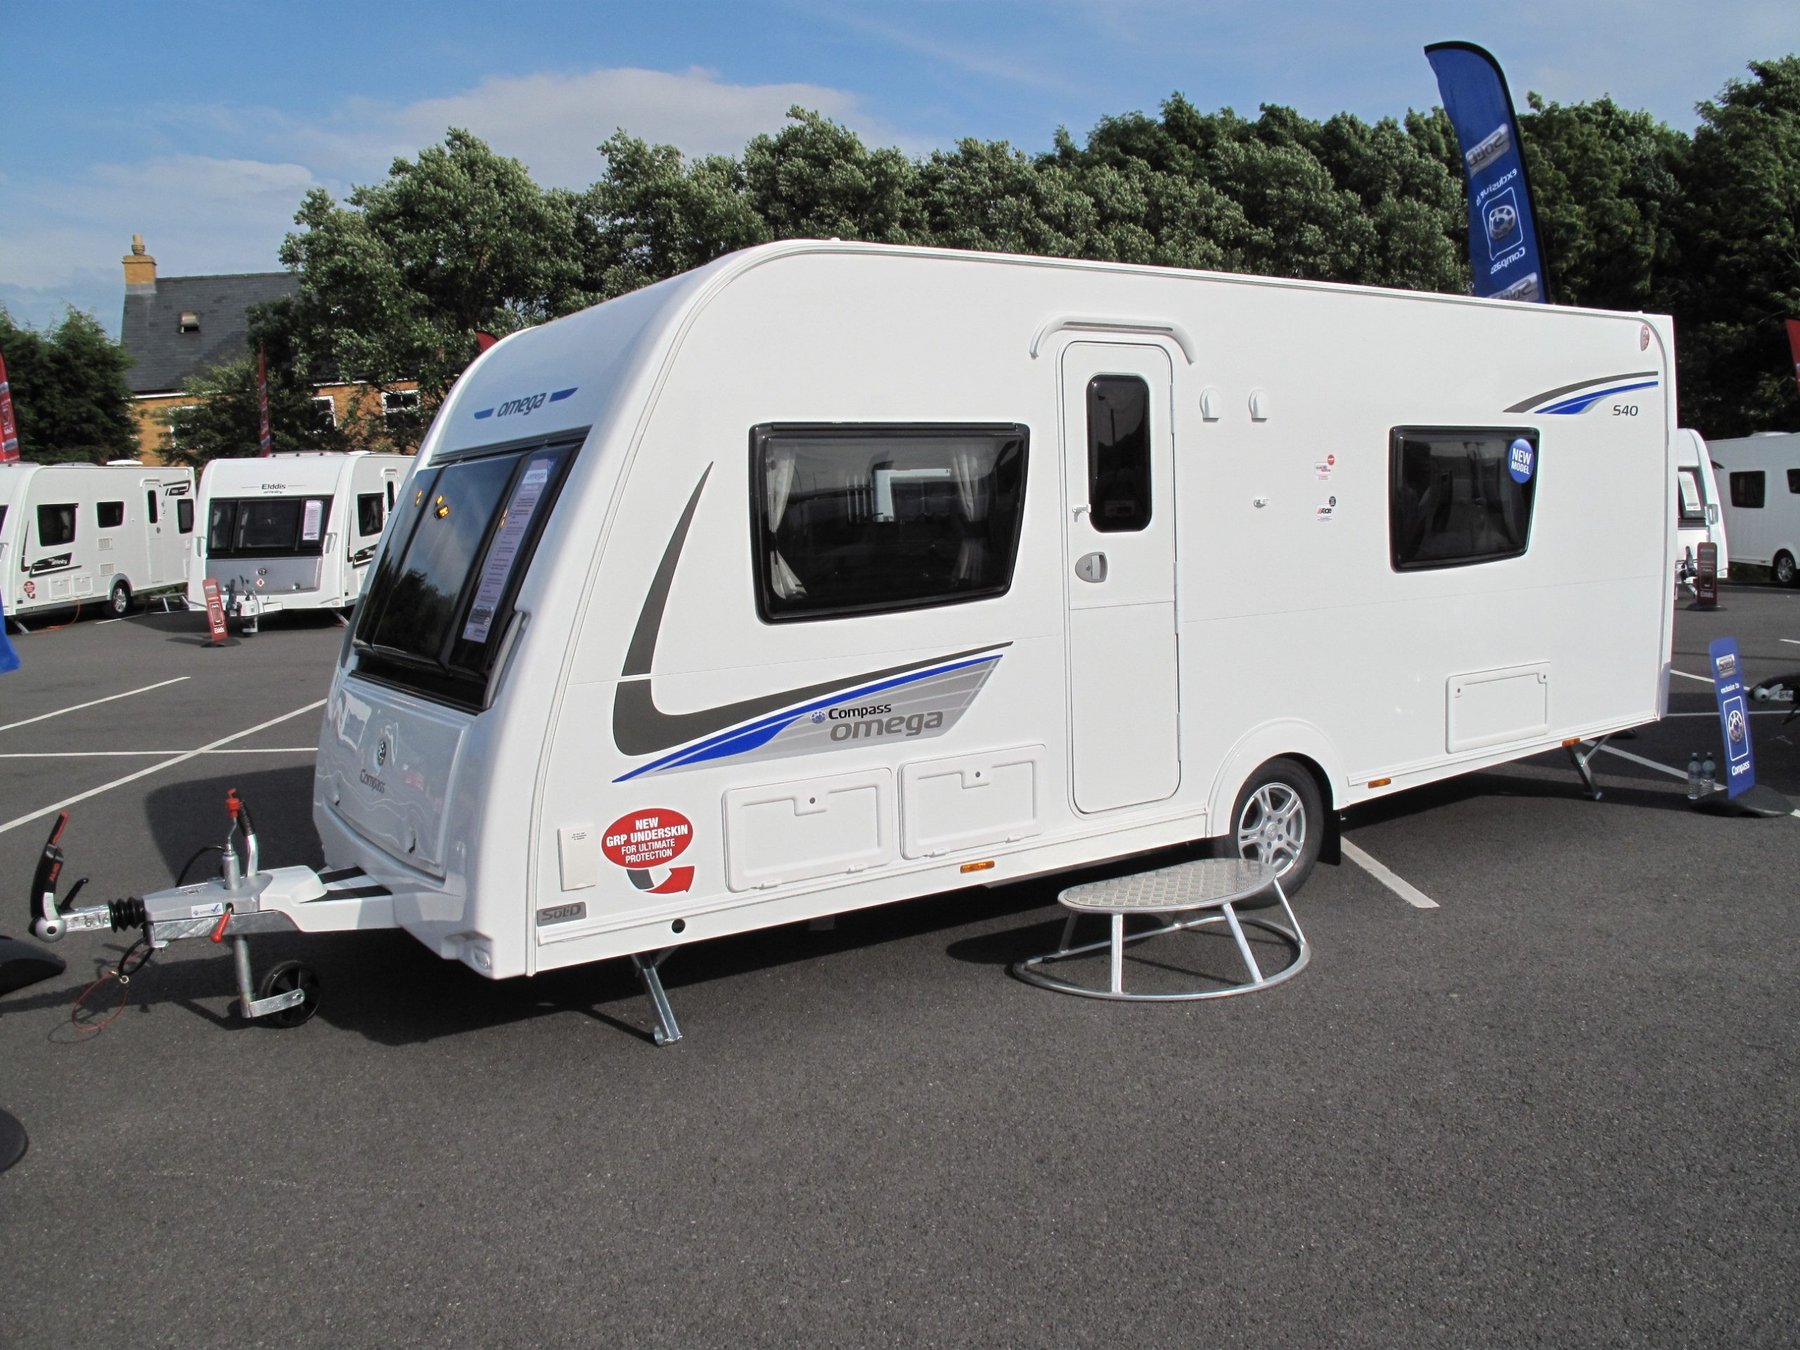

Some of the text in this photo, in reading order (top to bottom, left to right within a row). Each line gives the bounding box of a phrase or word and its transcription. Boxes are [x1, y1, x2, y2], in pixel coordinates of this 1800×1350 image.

[497, 392, 548, 418] omega
[1612, 404, 1639, 416] 540
[1511, 447, 1532, 465] NEW
[1510, 460, 1530, 475] MODEL
[828, 703, 892, 720] Compass
[830, 711, 944, 742] omega
[635, 817, 659, 831] NEW
[606, 834, 627, 847] GRP
[630, 824, 689, 843] UNDERSKIN
[621, 838, 676, 855] FOR ULTIMATE
[625, 848, 673, 864] PROTECTION
